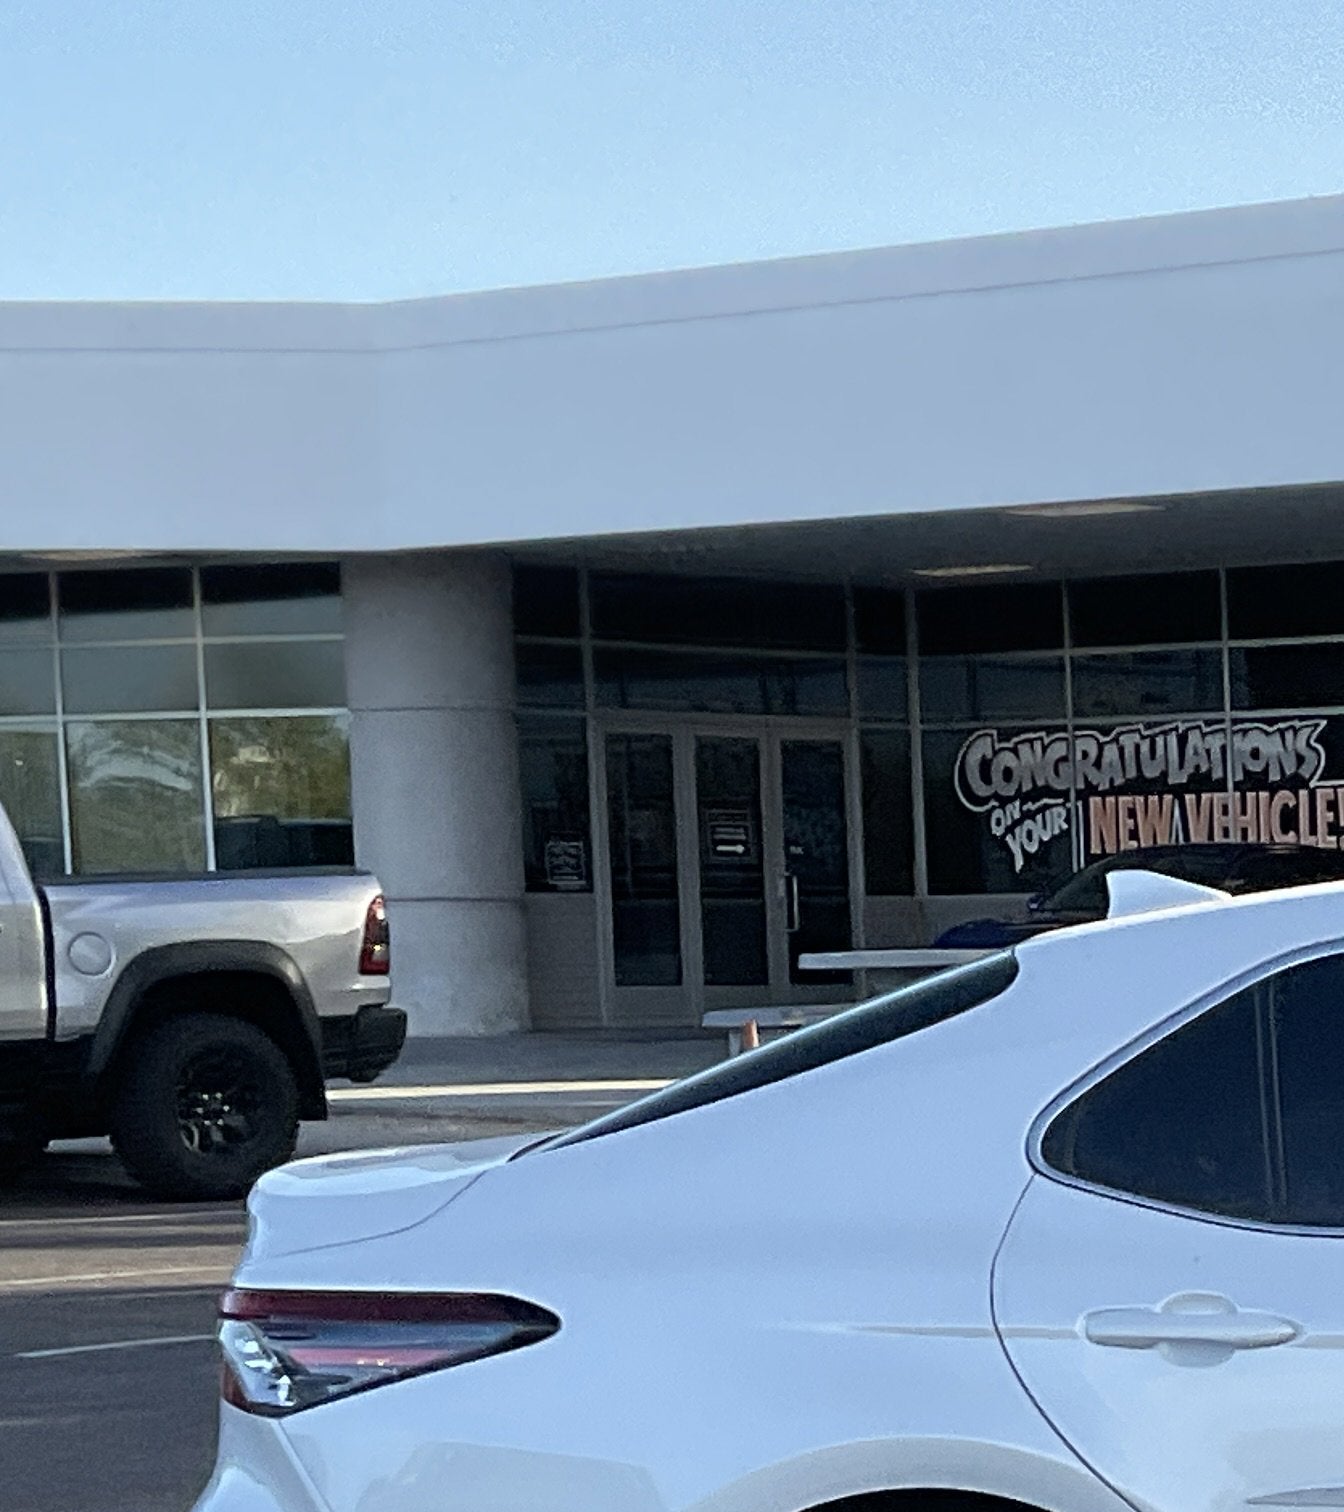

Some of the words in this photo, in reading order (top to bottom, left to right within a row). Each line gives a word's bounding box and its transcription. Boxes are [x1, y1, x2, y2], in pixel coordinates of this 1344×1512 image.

[965, 727, 1319, 797] CONGRATULATIONS
[990, 798, 1021, 836] ON
[1005, 806, 1069, 874] YOUR
[1088, 794, 1174, 855] NEW
